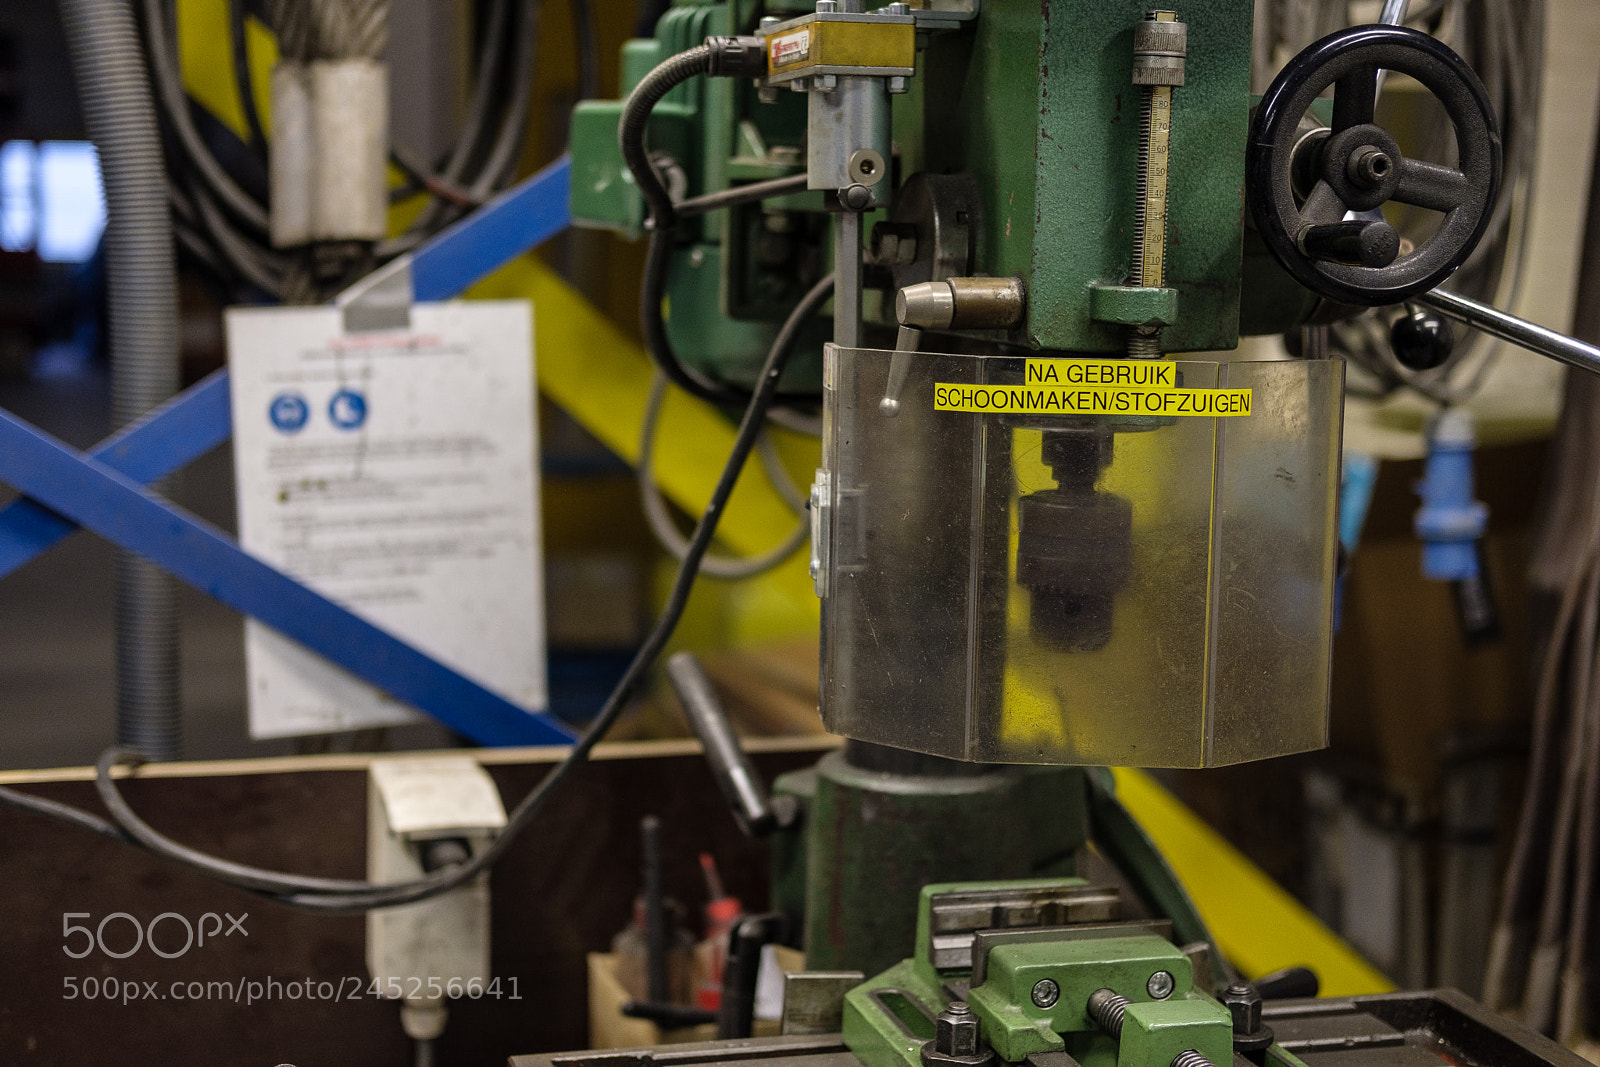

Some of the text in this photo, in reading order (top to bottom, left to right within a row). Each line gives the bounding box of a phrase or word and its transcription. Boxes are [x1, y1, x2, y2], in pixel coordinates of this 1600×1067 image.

[1158, 100, 1169, 108] 80
[1158, 122, 1168, 130] 70
[1156, 145, 1167, 153] 60
[1155, 167, 1166, 175] 50
[1154, 189, 1165, 197] 40
[1152, 234, 1162, 242] 20
[1151, 256, 1161, 264] 10
[1028, 363, 1171, 386] NA GEBRUIK
[936, 387, 1251, 413] SCHOONMAKEN/STOFZUIGEN
